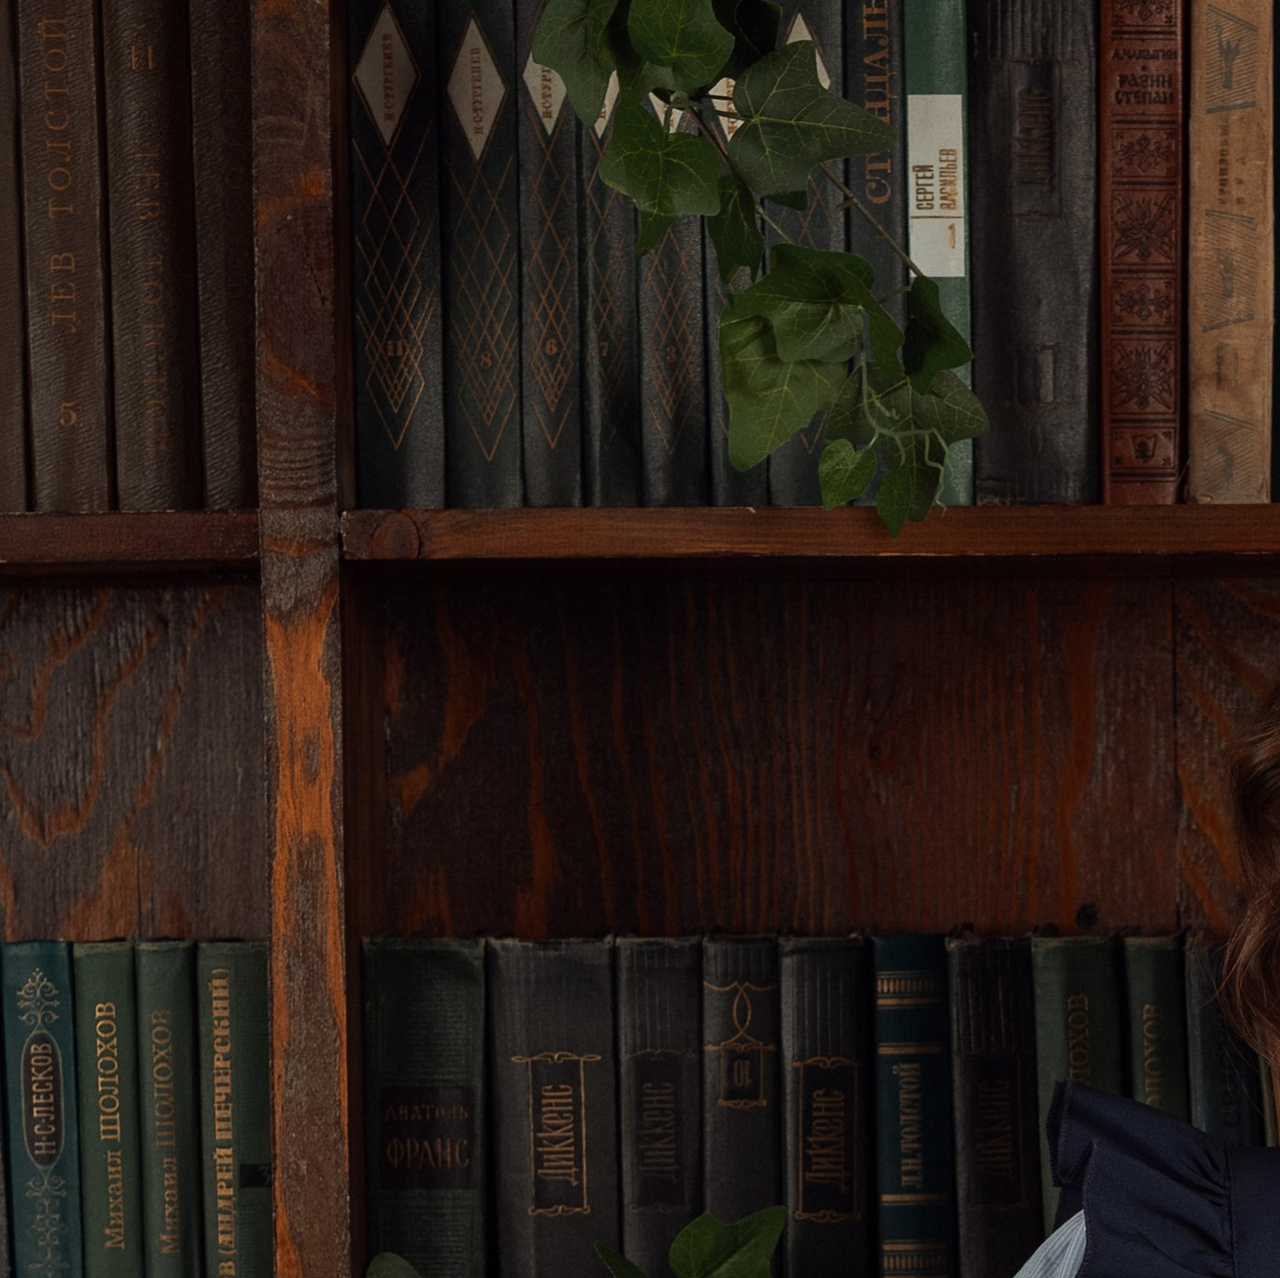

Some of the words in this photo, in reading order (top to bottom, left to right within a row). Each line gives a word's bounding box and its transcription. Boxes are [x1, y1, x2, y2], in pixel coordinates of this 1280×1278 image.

[42, 17, 75, 220] ТОЛСТОЙ
[912, 164, 934, 211] СЕРГЕЙ
[49, 250, 77, 334] ЛЕВ
[546, 339, 558, 357] 6
[60, 401, 79, 428] 5
[96, 1001, 121, 1142] ШОЛОХОВ
[152, 1008, 177, 1151] ШОЛОХОВ
[384, 1103, 471, 1122] АНАТОЛЬ
[384, 1137, 472, 1170] ФРАНС
[537, 1083, 580, 1188] Диккенс
[638, 1082, 680, 1186] Диккенс
[805, 1086, 850, 1194] Диккенс
[105, 1149, 127, 1251] Михаил
[159, 1158, 182, 1256] Михаил
